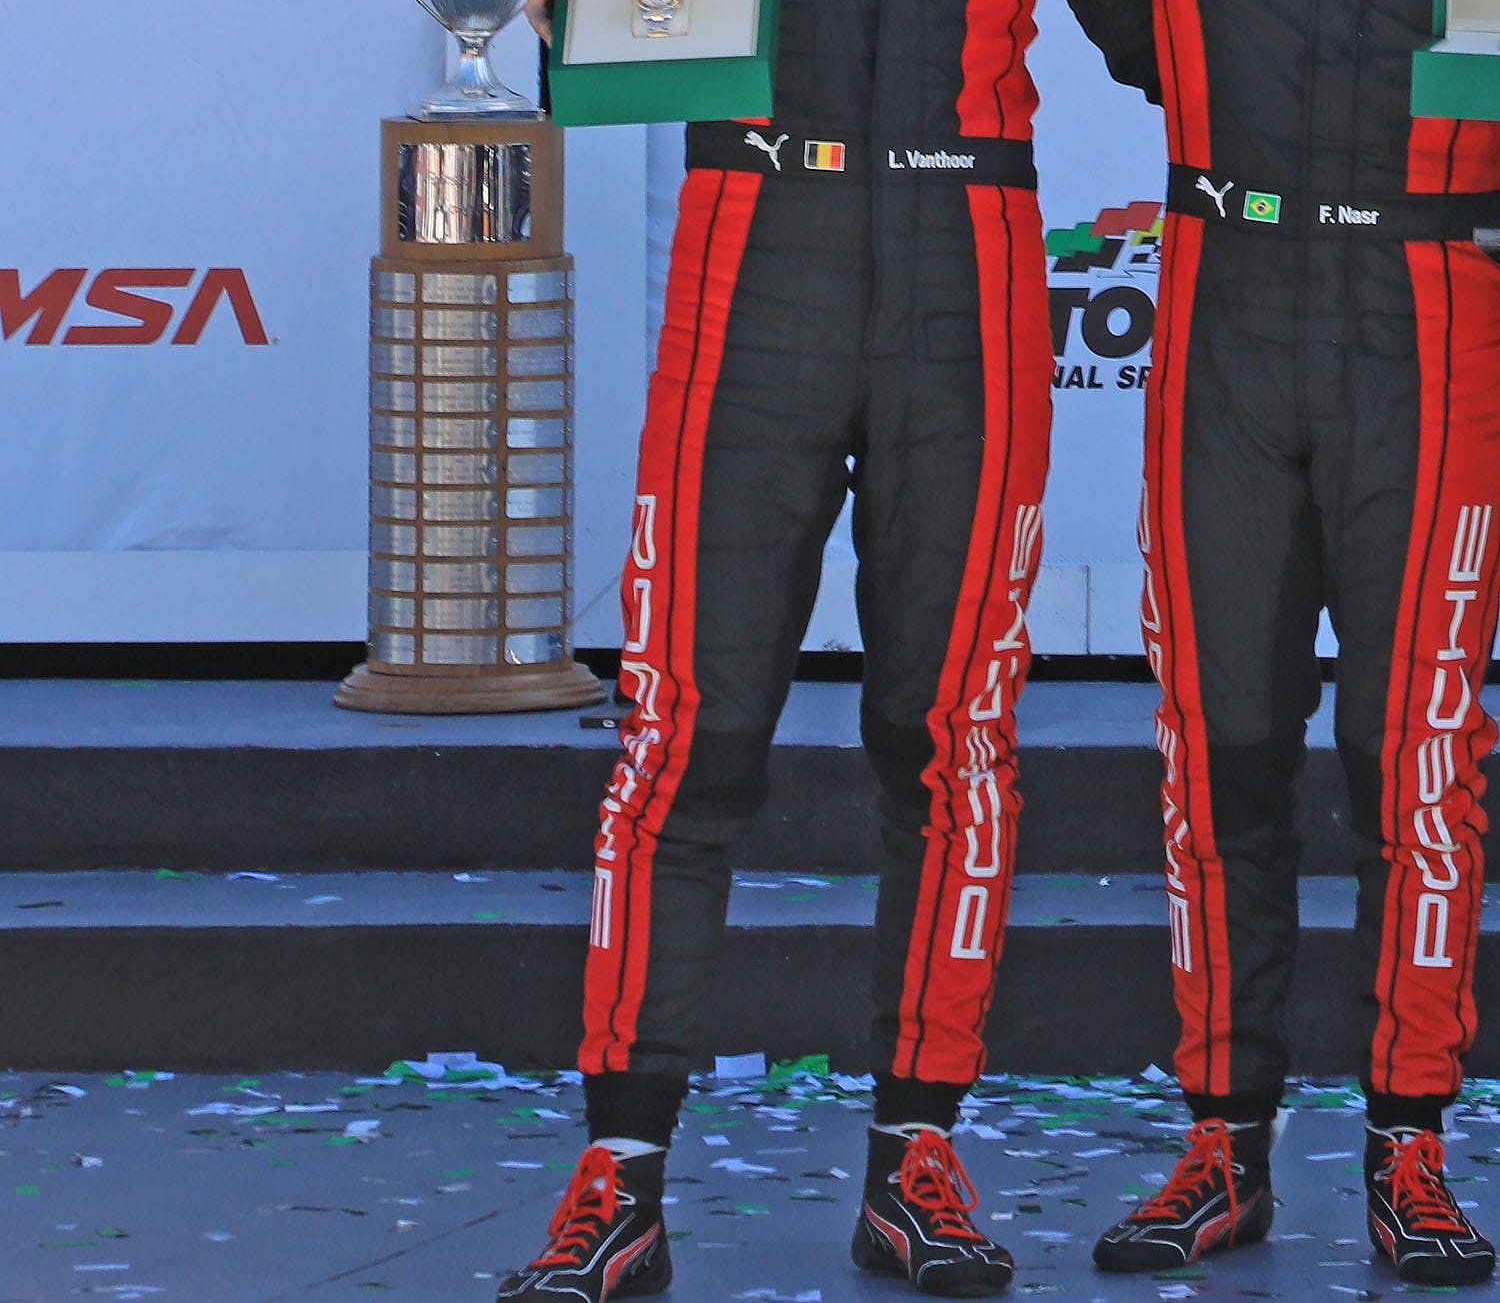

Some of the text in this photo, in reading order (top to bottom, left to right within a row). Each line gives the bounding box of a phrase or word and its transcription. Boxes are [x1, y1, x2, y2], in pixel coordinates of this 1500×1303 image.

[888, 148, 977, 170] L. Vanthoor
[1319, 204, 1381, 226] F. Nasr
[1412, 502, 1493, 969] PORSCHE
